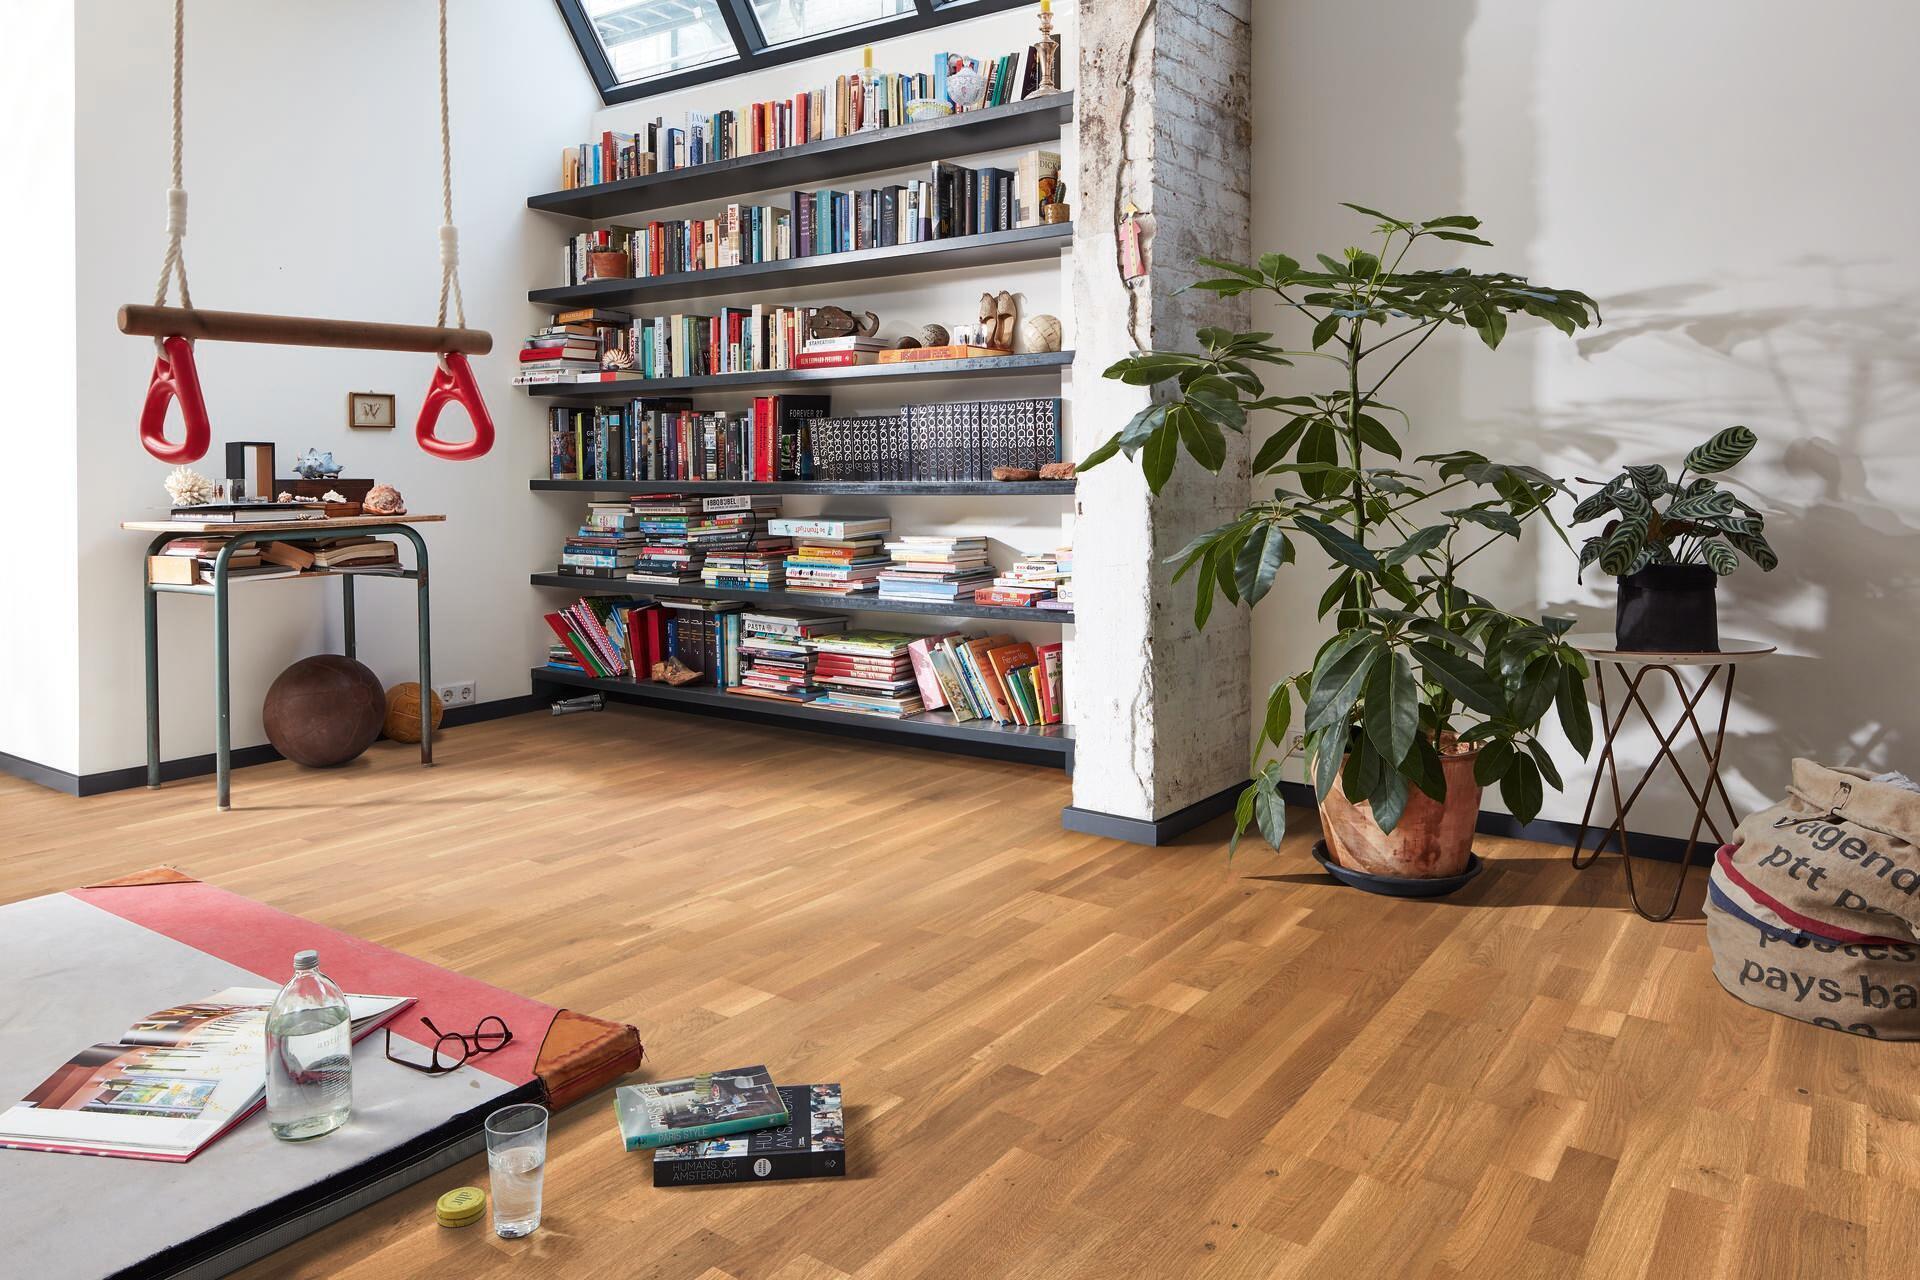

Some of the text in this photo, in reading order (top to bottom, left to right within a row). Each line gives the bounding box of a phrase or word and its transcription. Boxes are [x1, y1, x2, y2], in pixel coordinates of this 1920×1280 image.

[789, 409, 814, 418] FOREVER
[900, 407, 909, 450] SNOECKS
[910, 407, 919, 450] SNOECKS
[919, 406, 928, 450] SNOECKS
[928, 405, 936, 448] SNOECKS
[936, 404, 945, 448] SNOECKS
[945, 404, 953, 448] SNOECKS
[953, 404, 962, 447] SNOECKS
[962, 404, 971, 448] SNOECKS
[971, 404, 979, 448] SNOECKS
[981, 404, 989, 447] SNOECKS
[990, 404, 999, 448] SNOECKS
[999, 403, 1007, 447] SNOECKS
[1008, 403, 1016, 448] SNOECKS
[1017, 402, 1025, 447] SNOECKS
[1026, 401, 1035, 447] SNOECKS
[1036, 400, 1045, 446] SNOECKS
[1045, 400, 1054, 446] SNOECKS
[817, 418, 828, 456] SNOECKS
[832, 420, 843, 461] SNOECKS
[842, 420, 852, 461] SNOECKS
[852, 420, 862, 461] SNOECKS
[861, 420, 870, 460] SNOECKS
[869, 419, 879, 460] SNOECKS
[879, 418, 888, 460] SNOECKS
[888, 417, 898, 459] SNOECKS
[747, 623, 765, 631] PASTA
[1758, 844, 1828, 891] ptt
[658, 1127, 708, 1144] PARIS STYLE
[672, 1159, 736, 1173] HUMANS OF
[672, 1169, 737, 1181] AMSTERDAM
